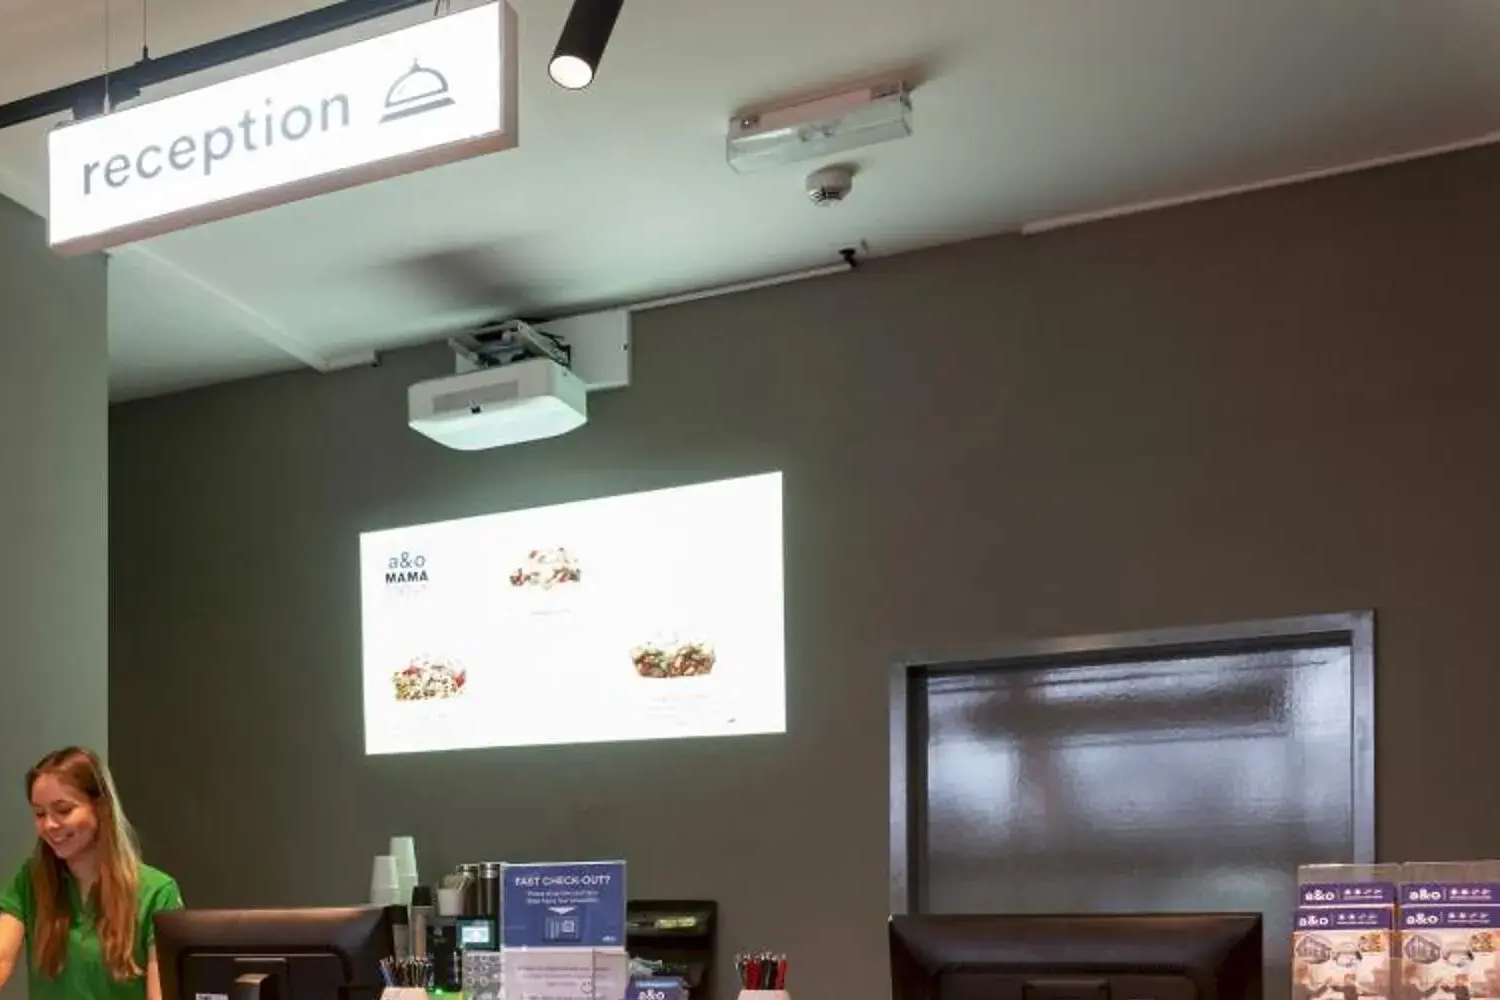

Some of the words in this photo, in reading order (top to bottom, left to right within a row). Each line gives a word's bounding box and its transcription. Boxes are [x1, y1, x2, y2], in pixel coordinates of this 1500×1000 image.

[81, 88, 351, 196] reception
[387, 551, 426, 569] a&o
[385, 569, 428, 584] MAMA
[515, 876, 540, 886] FAST
[1304, 888, 1335, 901] a&o
[1408, 887, 1441, 901] a&o
[1298, 914, 1329, 927] a&o
[1406, 912, 1439, 926] a&o
[637, 988, 665, 1000] a&o
